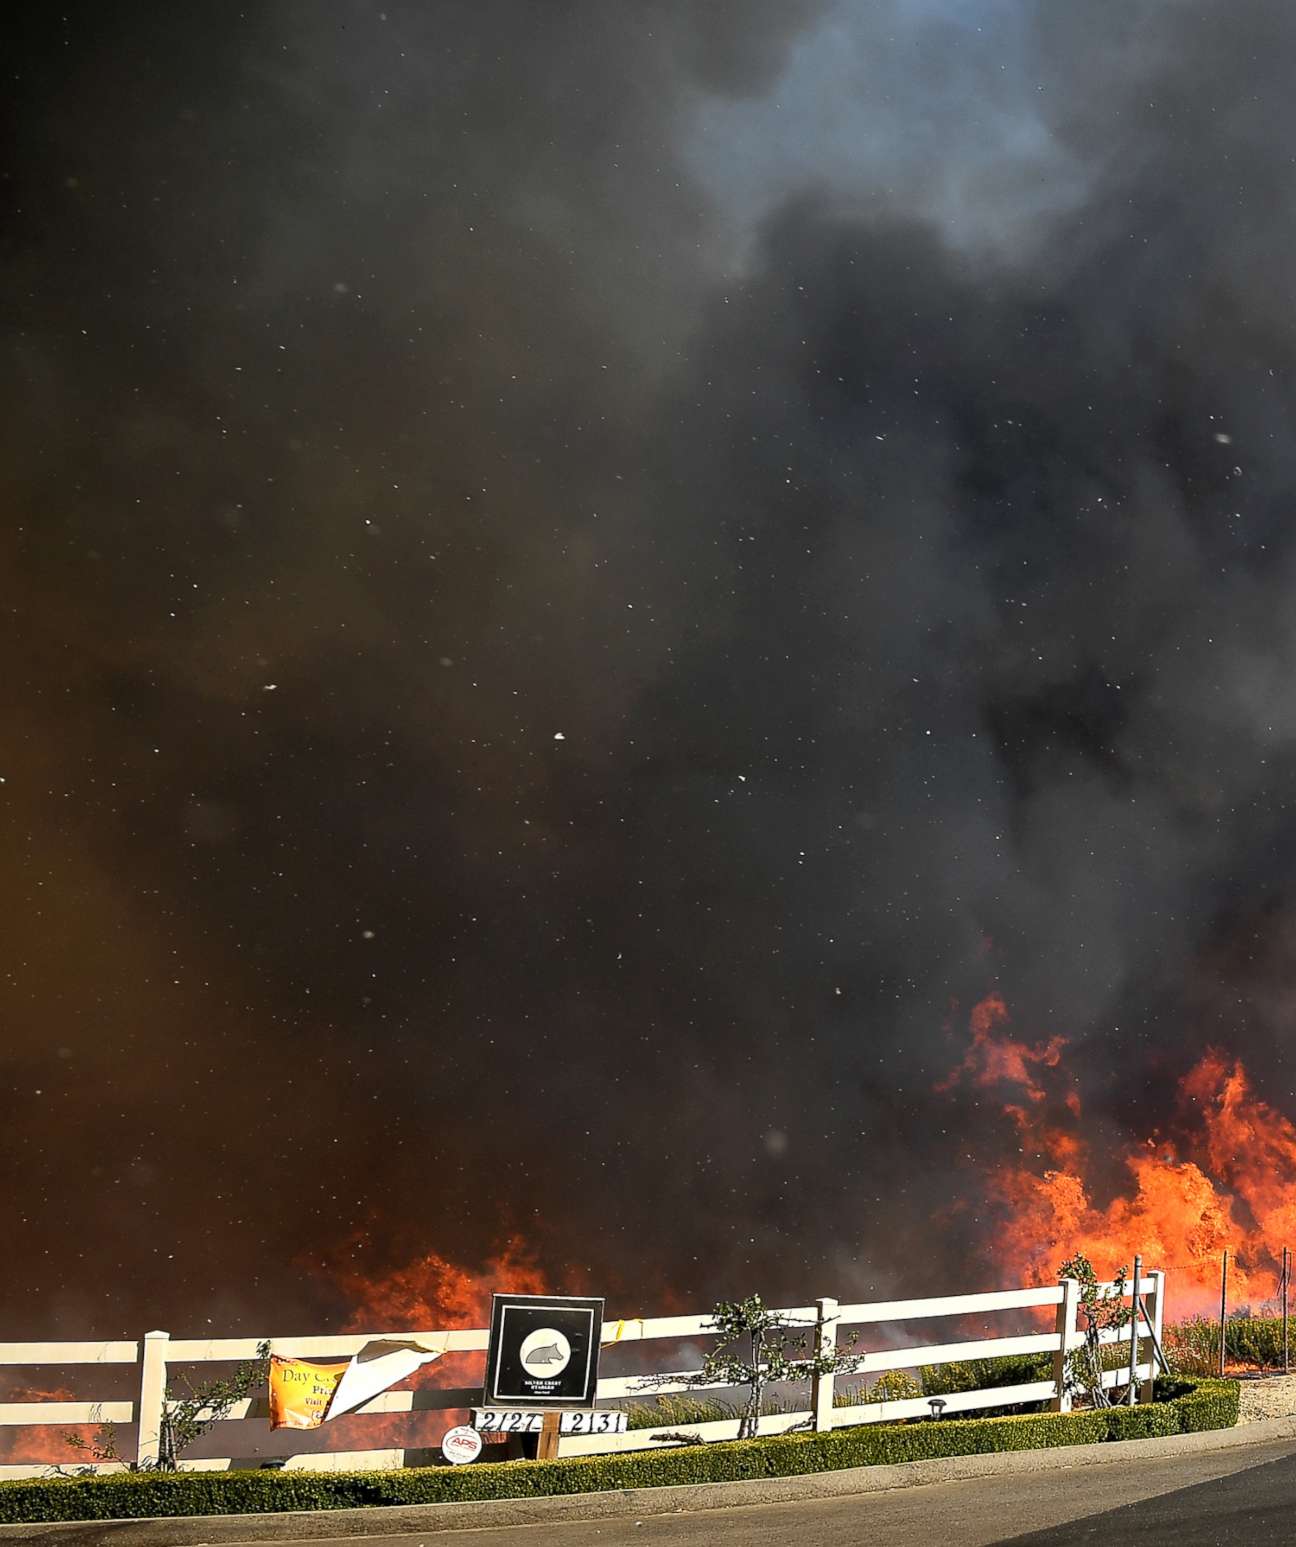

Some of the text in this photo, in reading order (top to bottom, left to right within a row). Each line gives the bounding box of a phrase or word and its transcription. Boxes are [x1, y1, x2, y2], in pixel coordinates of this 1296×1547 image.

[283, 1369, 310, 1385] Day
[305, 1398, 322, 1406] Visit
[482, 1412, 543, 1432] 2127
[572, 1412, 621, 1432] 2131
[452, 1437, 478, 1450] APS
